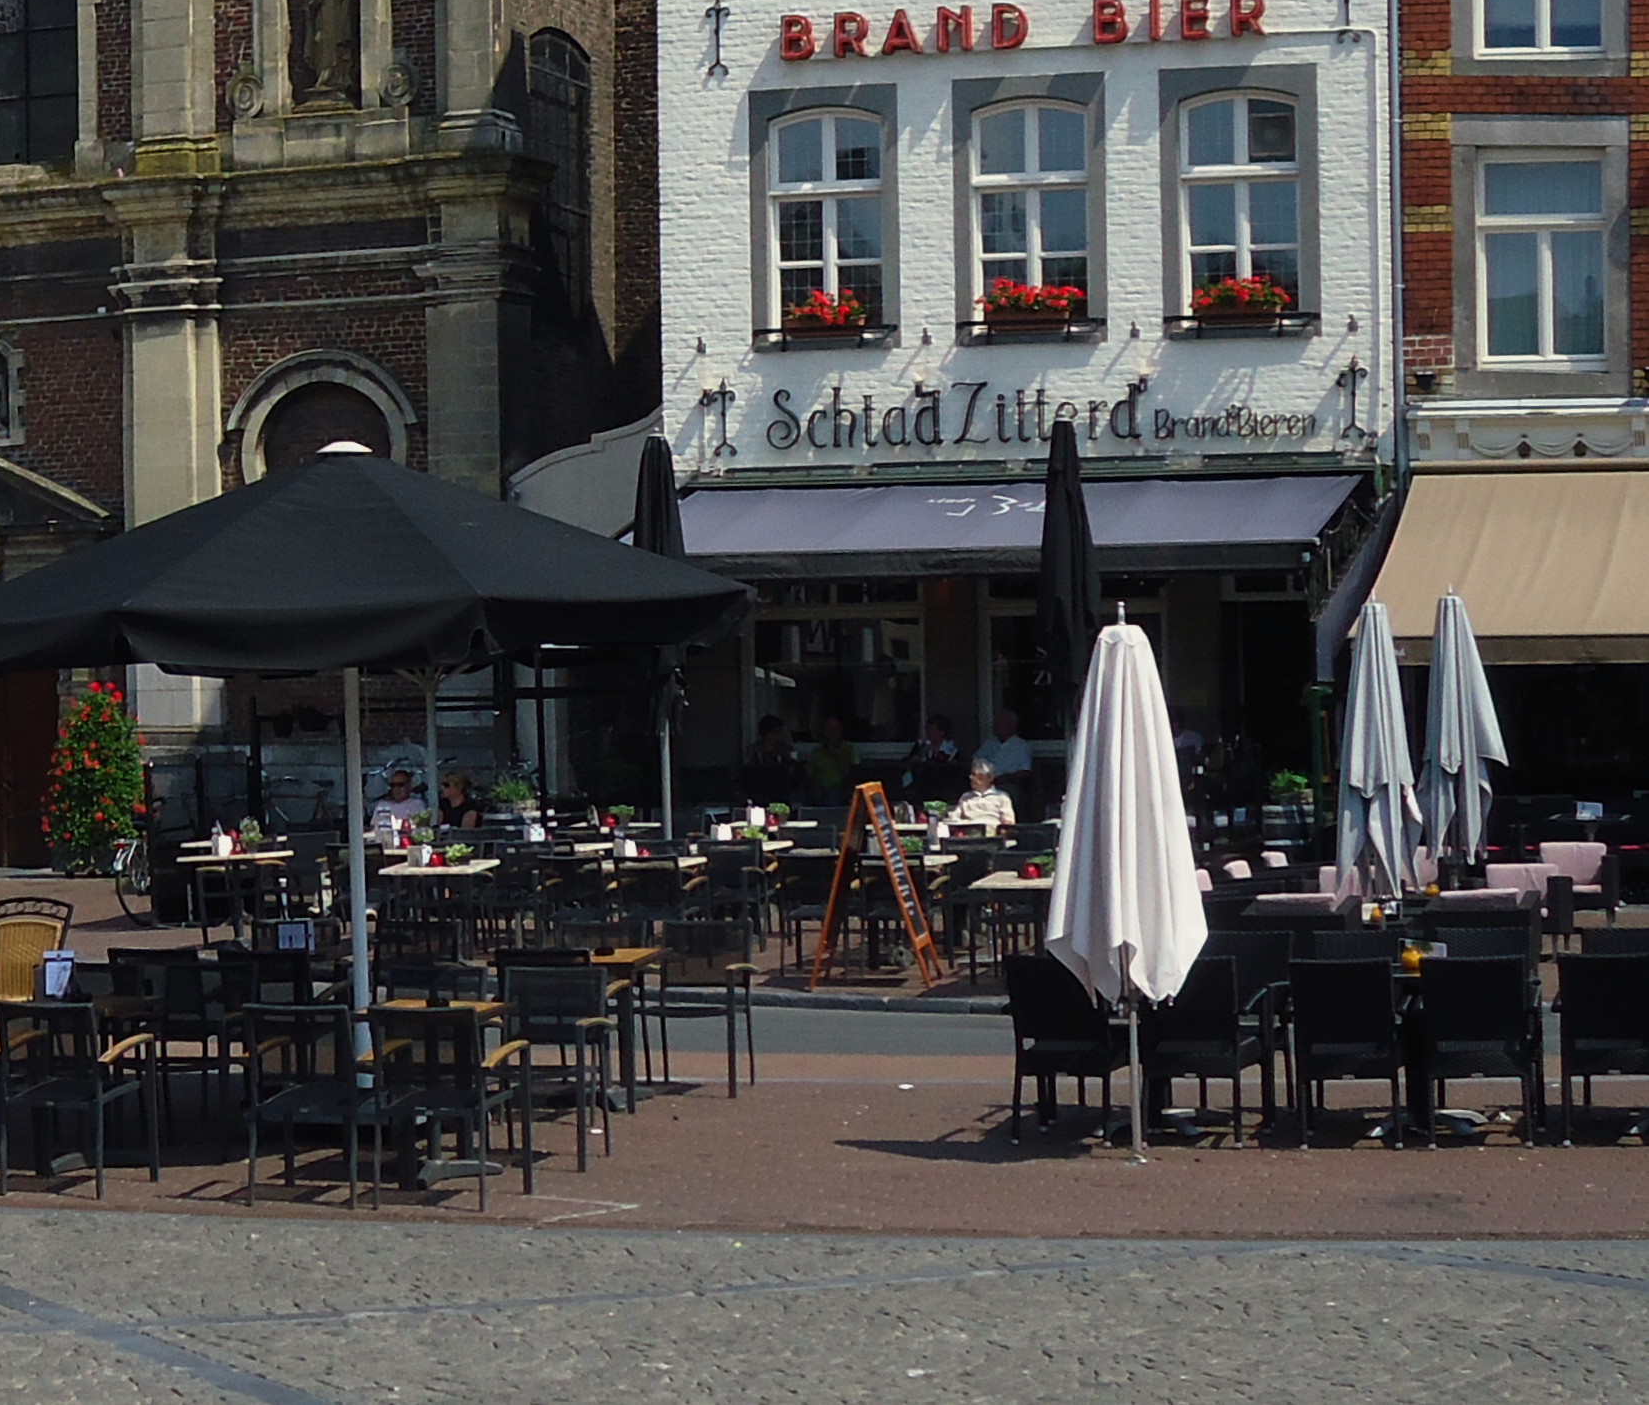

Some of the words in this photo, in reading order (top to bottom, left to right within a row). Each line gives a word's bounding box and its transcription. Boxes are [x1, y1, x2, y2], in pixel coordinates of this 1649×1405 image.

[780, 3, 1030, 60] BRAND
[766, 384, 946, 450] Schtad
[1153, 403, 1233, 440] Brand
[1236, 404, 1317, 440] Bieren
